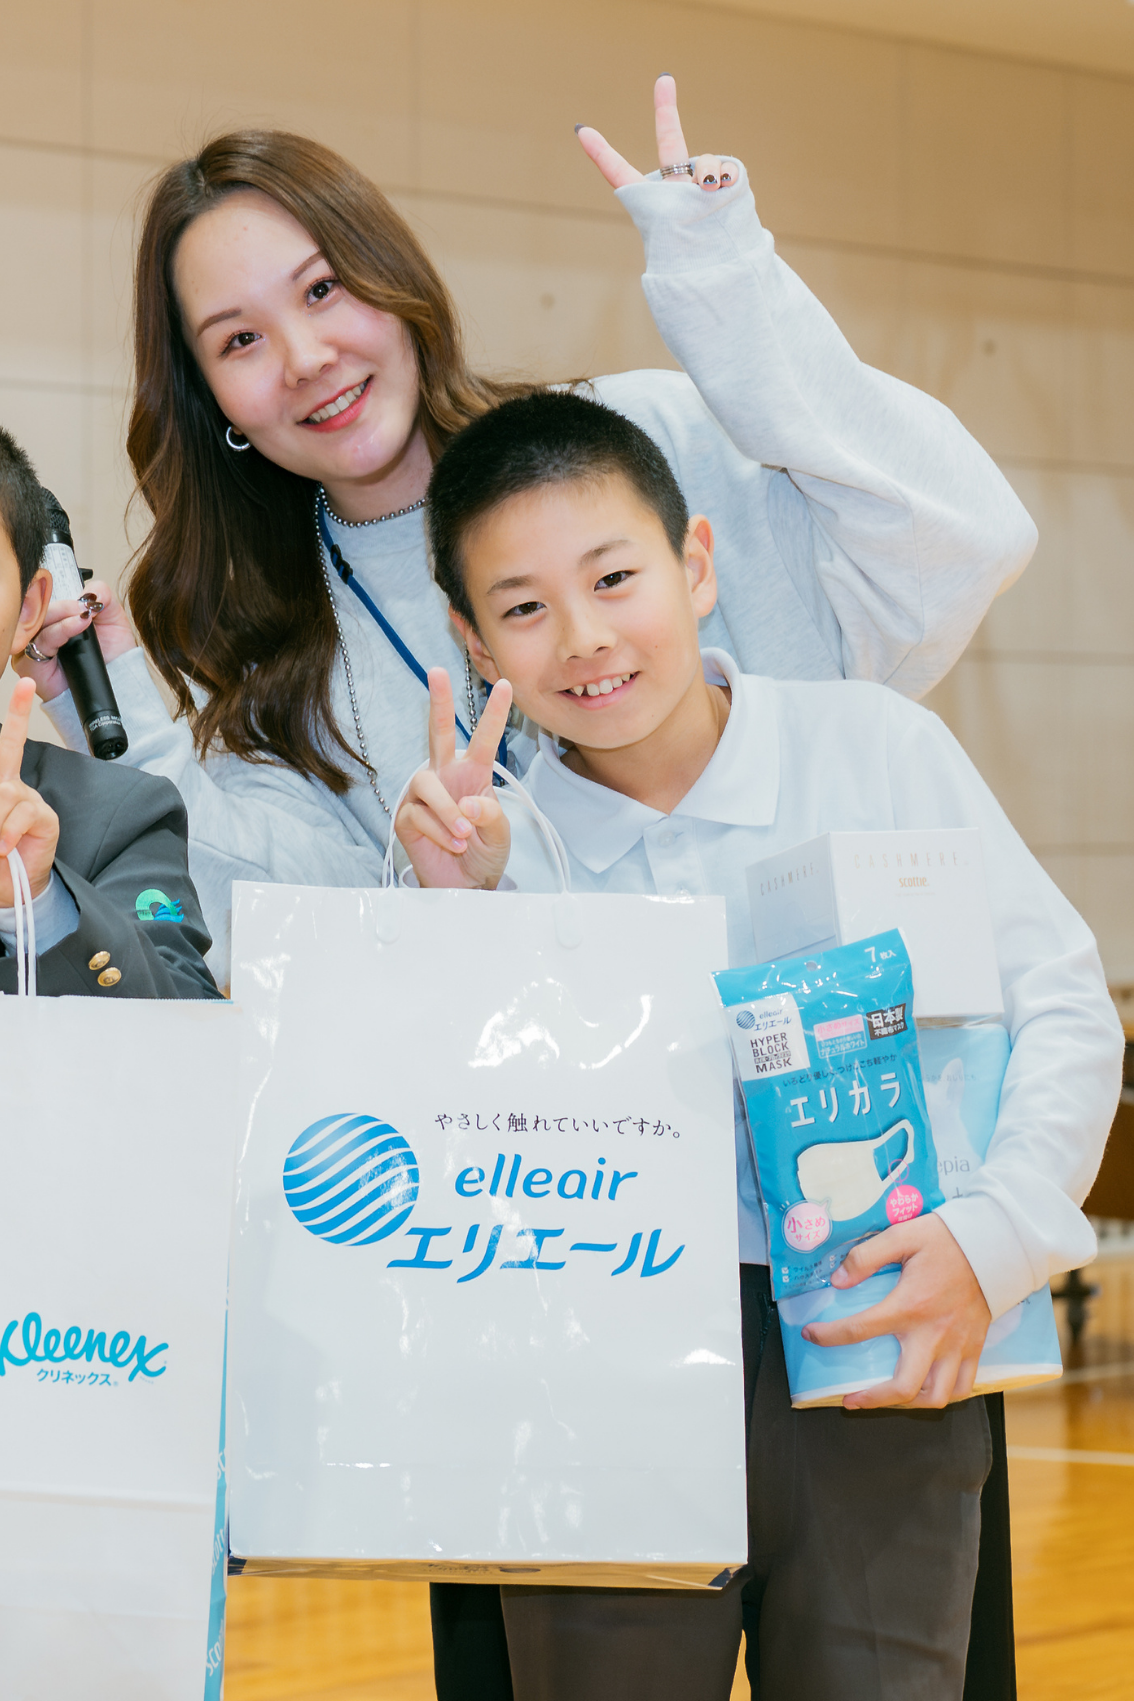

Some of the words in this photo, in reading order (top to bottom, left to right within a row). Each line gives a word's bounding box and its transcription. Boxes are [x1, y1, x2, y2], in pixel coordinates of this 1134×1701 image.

[754, 1016, 792, 1031] エリエール
[871, 1006, 904, 1028] 日本製
[750, 1032, 788, 1048] HYPER
[752, 1041, 790, 1058] BLOCK
[755, 1058, 792, 1073] MASK
[790, 1073, 902, 1128] エリカラ
[434, 1112, 681, 1139] やさしく触れていいですか。
[454, 1153, 638, 1201] elleair
[890, 1193, 919, 1208] やわらか
[892, 1203, 919, 1217] フィット
[787, 1215, 826, 1234] 小さめ
[795, 1230, 821, 1243] サイズ
[386, 1223, 686, 1284] エリエール
